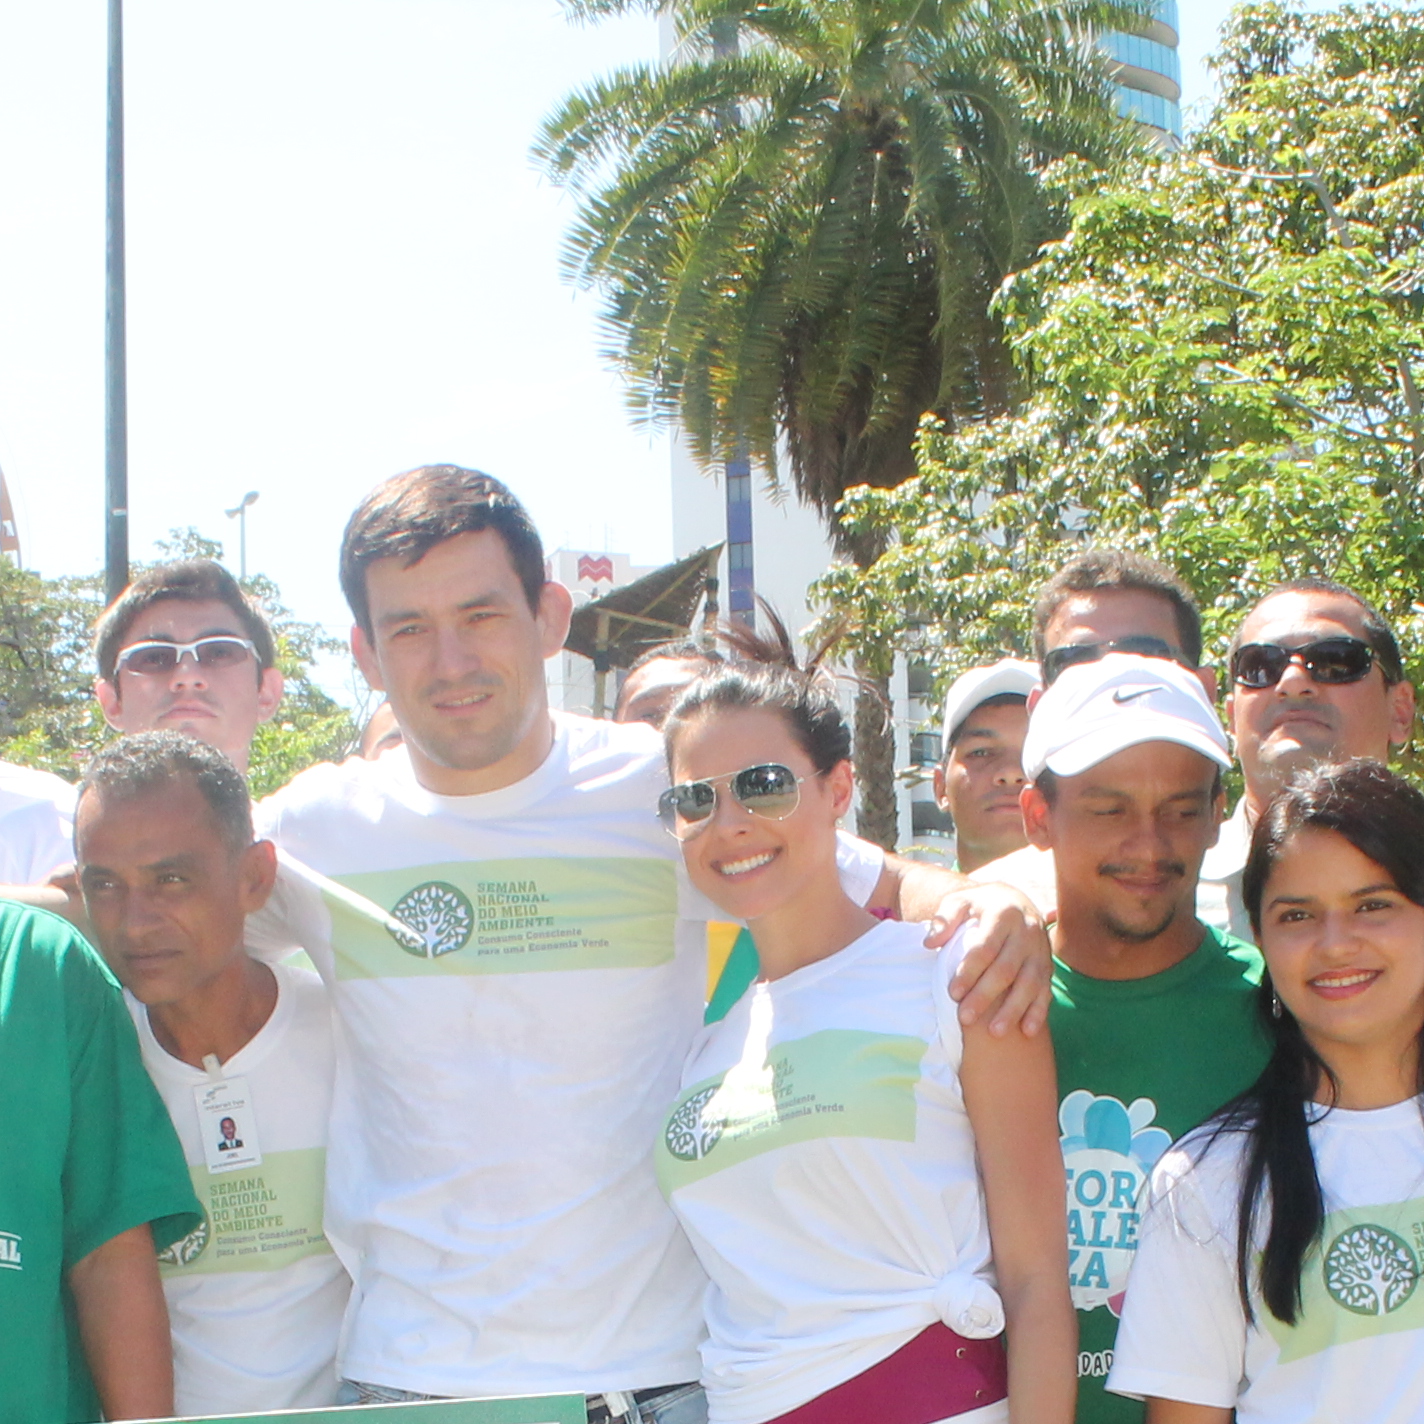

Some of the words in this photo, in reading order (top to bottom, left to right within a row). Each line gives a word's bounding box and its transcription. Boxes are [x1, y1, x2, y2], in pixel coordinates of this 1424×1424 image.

[478, 881, 536, 893] SEMANA
[478, 894, 549, 906] NACIONAL
[478, 908, 496, 920] DO
[502, 904, 538, 916] MEIO
[478, 916, 554, 932] AMBIENTE
[478, 934, 523, 944] Consumo
[526, 928, 582, 940] Consciente
[478, 946, 499, 956] para
[504, 946, 524, 954] uma
[529, 940, 578, 952] Economia
[582, 938, 609, 947] Verde
[815, 1103, 844, 1113] Verde
[210, 1178, 264, 1196] SEMANA
[211, 1190, 276, 1209] NACIONAL
[213, 1211, 228, 1222] DO
[234, 1204, 266, 1218] MEIO
[216, 1215, 283, 1233] AMBIENTE
[217, 1236, 255, 1244] Consumo
[258, 1228, 307, 1240] Consciente
[262, 1239, 304, 1251] Economia
